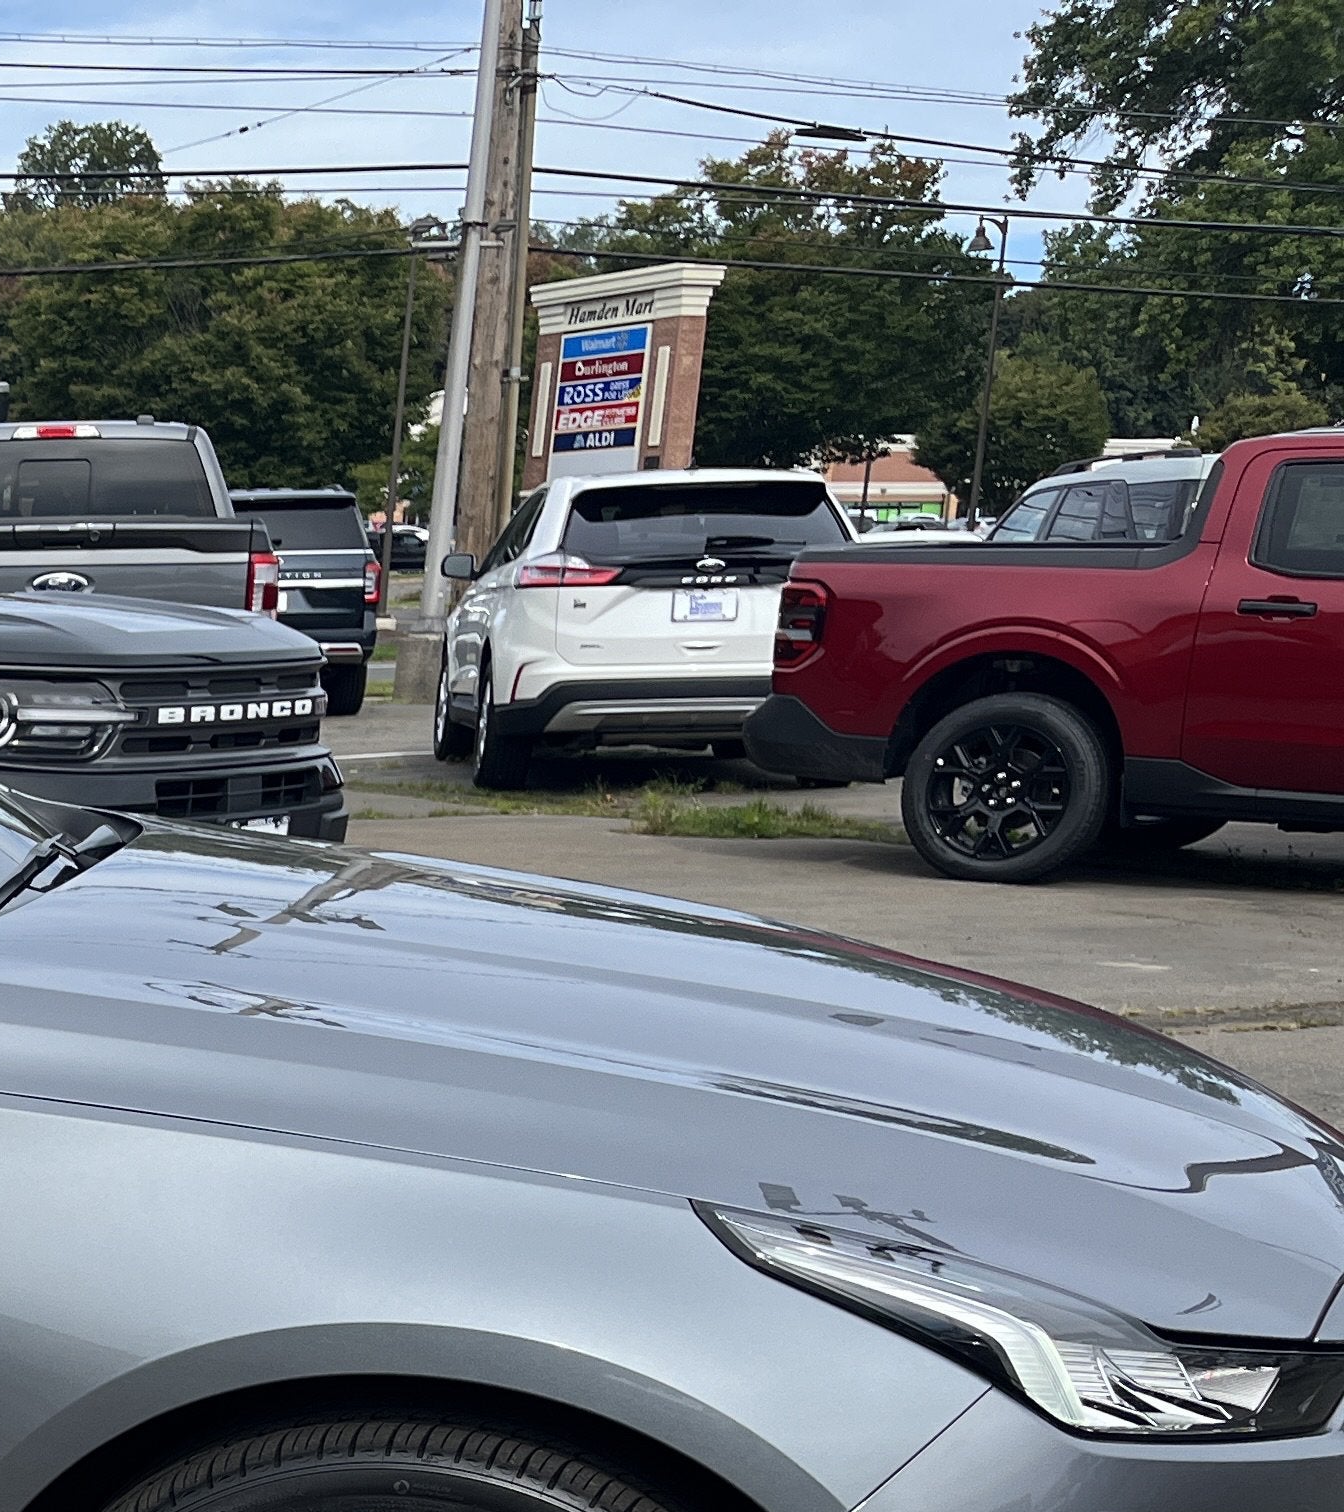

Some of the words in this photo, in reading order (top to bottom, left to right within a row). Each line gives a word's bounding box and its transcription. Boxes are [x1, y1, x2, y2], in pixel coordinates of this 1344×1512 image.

[568, 302, 619, 325] Hamden
[623, 298, 654, 317] Mart
[563, 383, 605, 405] ROSS
[559, 409, 605, 430] EDGE
[586, 431, 615, 448] ALDI
[158, 699, 312, 724] BRONCO
